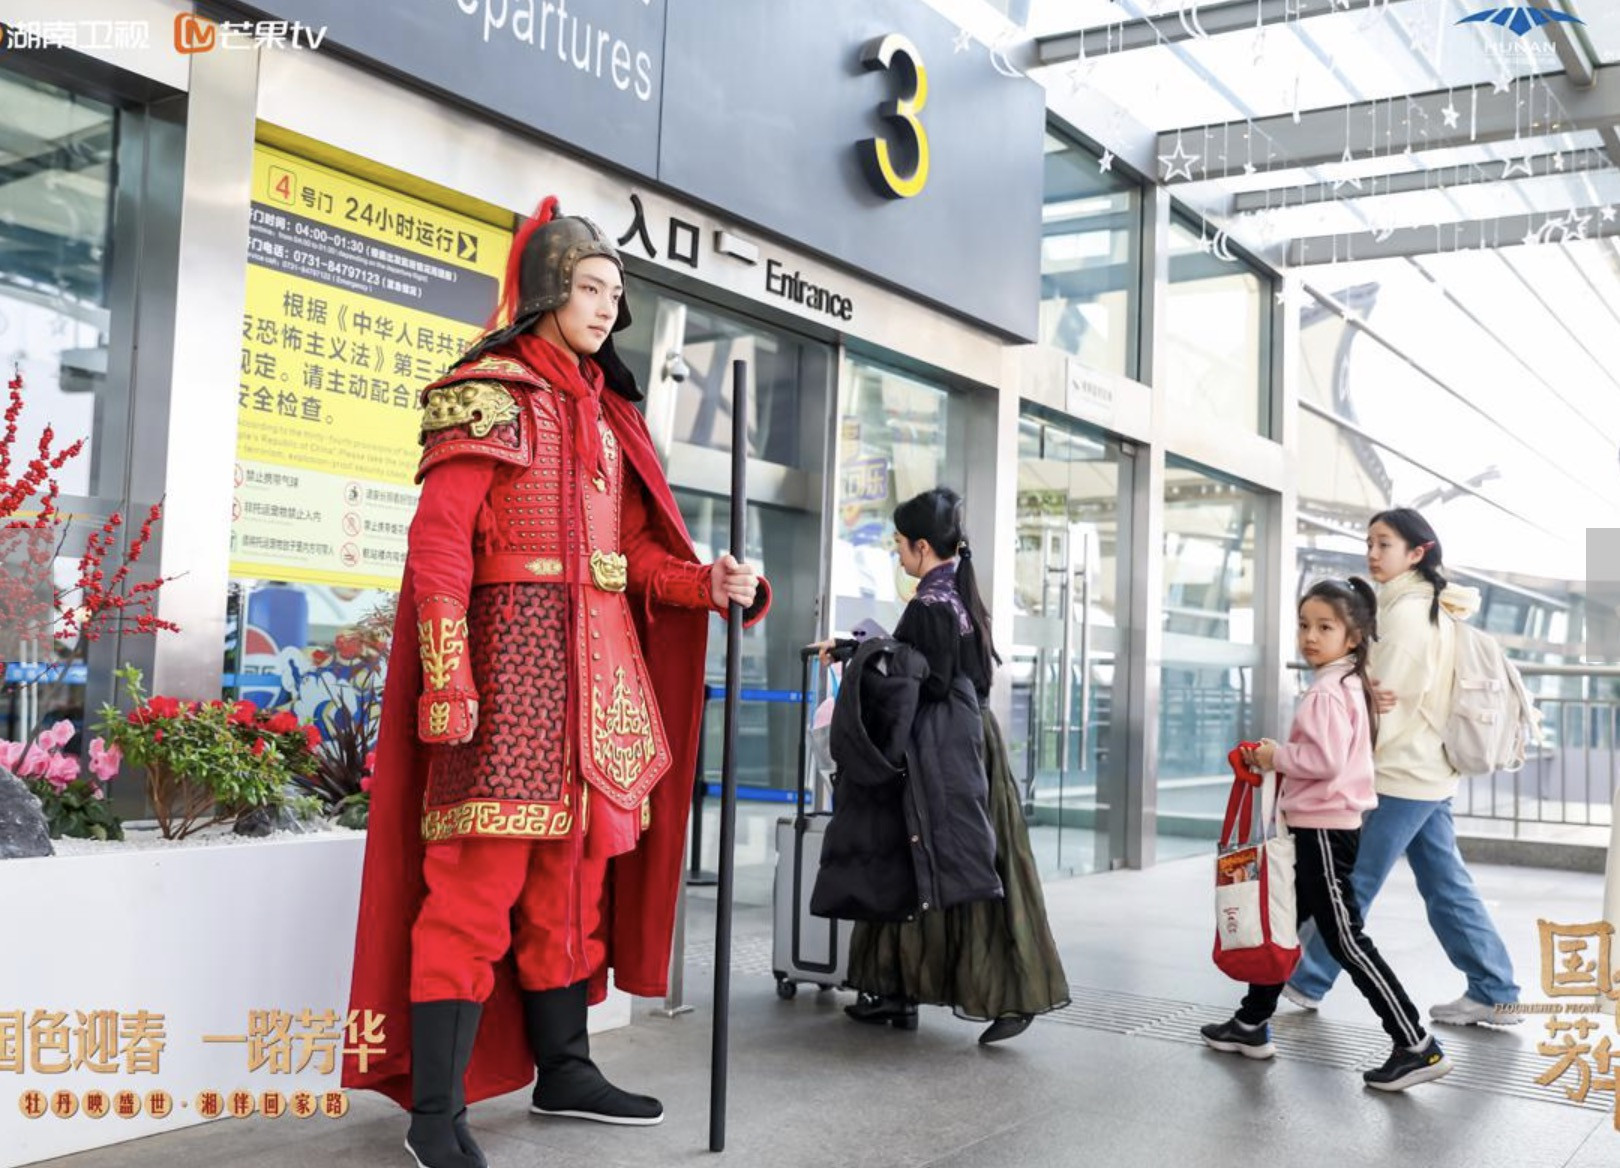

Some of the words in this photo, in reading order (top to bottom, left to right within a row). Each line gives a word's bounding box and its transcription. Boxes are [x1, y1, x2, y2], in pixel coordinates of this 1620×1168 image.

[860, 33, 929, 199] 3
[275, 174, 291, 200] 4
[300, 186, 333, 214] 号门
[345, 196, 455, 254] 24小时运行
[618, 193, 700, 269] 入口
[765, 258, 853, 322] Entrance
